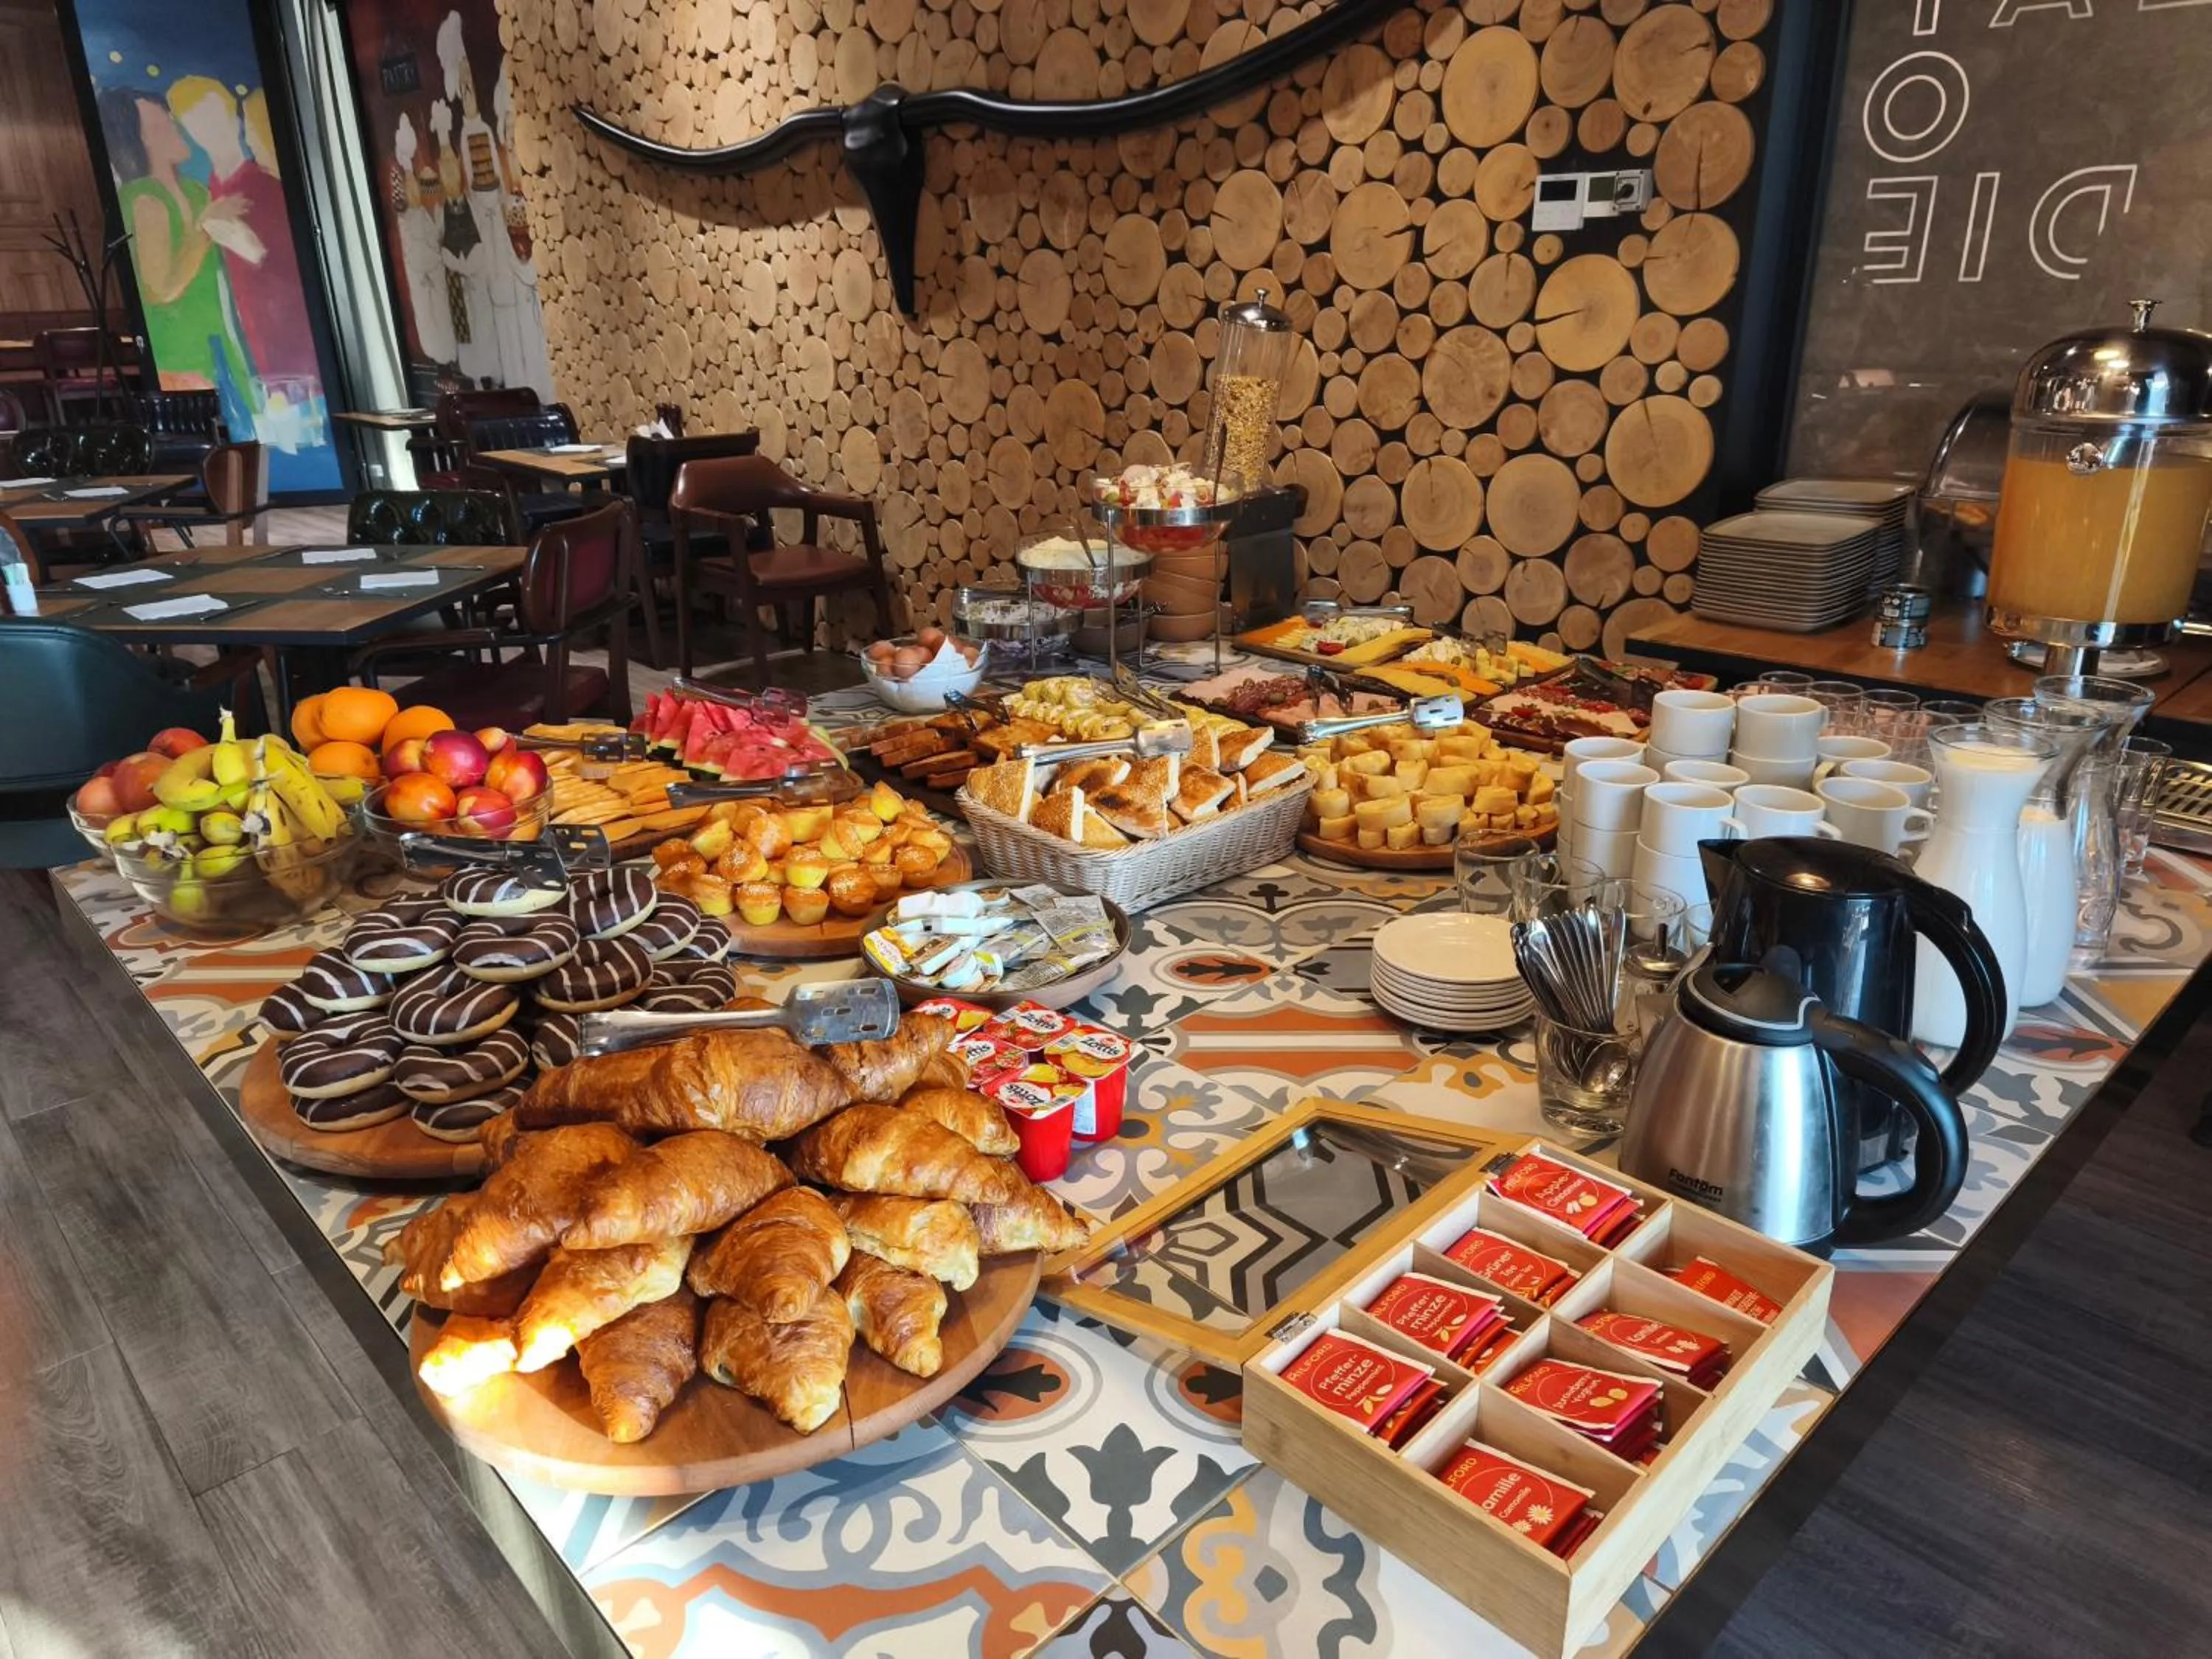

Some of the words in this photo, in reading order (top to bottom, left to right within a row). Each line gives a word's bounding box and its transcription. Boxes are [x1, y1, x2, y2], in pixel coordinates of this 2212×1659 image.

[1410, 1295, 1447, 1329] minze
[1333, 1359, 1374, 1396] minze
[1481, 1472, 1522, 1512] amille
